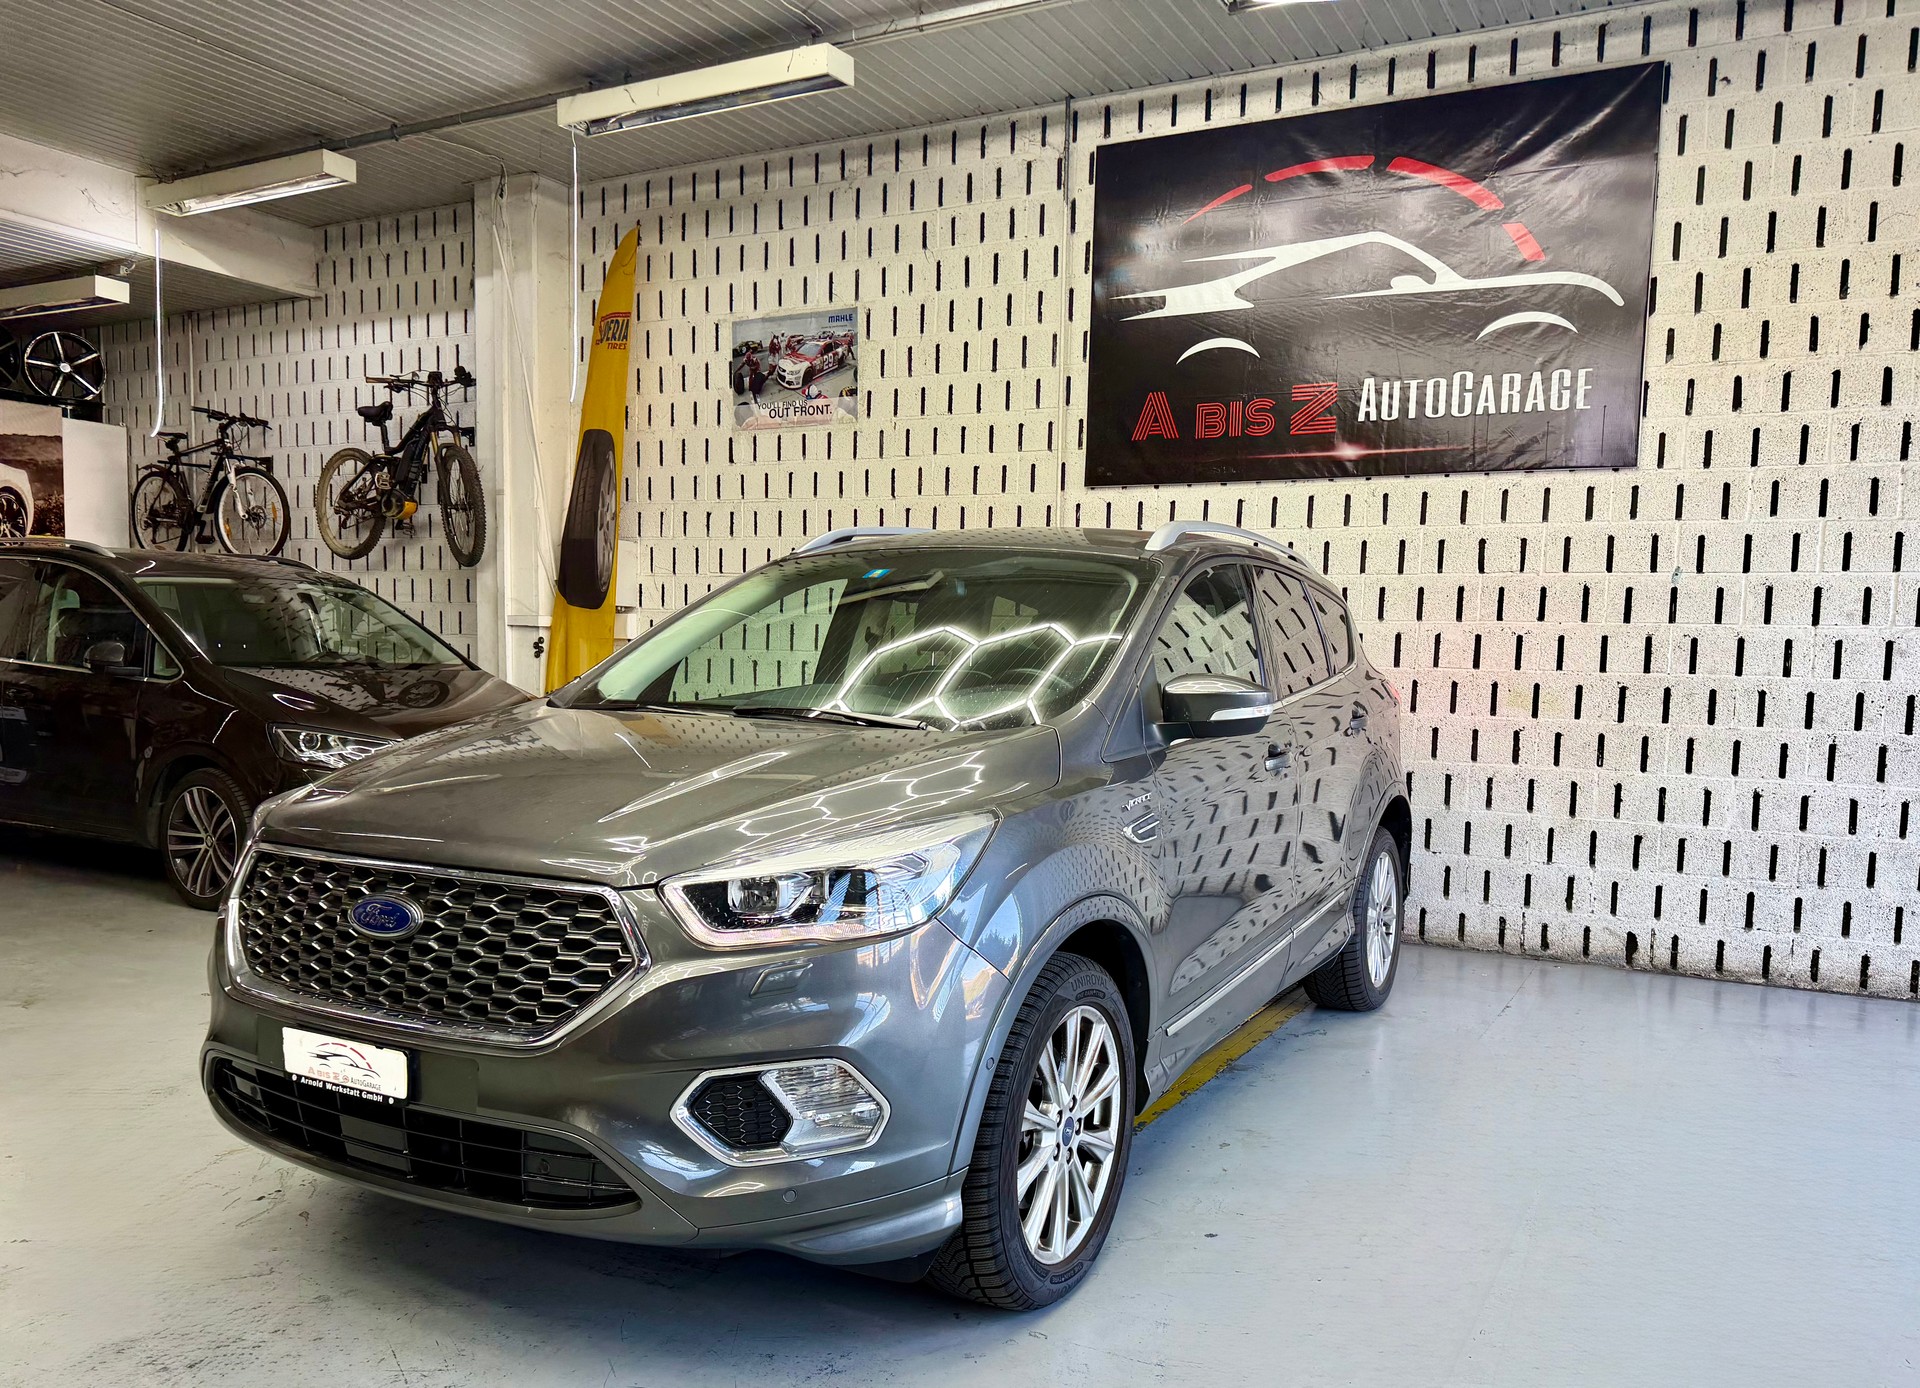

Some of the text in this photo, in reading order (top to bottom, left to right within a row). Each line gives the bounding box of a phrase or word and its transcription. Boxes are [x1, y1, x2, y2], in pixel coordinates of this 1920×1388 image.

[828, 313, 853, 323] MAHLE
[607, 342, 628, 350] TIRES
[757, 399, 808, 410] YOU'LL FIND US
[768, 404, 833, 419] OUT FRONT.
[1131, 390, 1180, 442] A
[1195, 397, 1276, 440] BIS
[1290, 381, 1339, 436] Z
[361, 903, 401, 928] Ford
[1071, 974, 1109, 992] UNIROYAL
[308, 1066, 315, 1075] A
[316, 1069, 330, 1079] BIS
[332, 1071, 341, 1080] Z
[300, 1076, 383, 1103] Arnold Werkstatt GmbH
